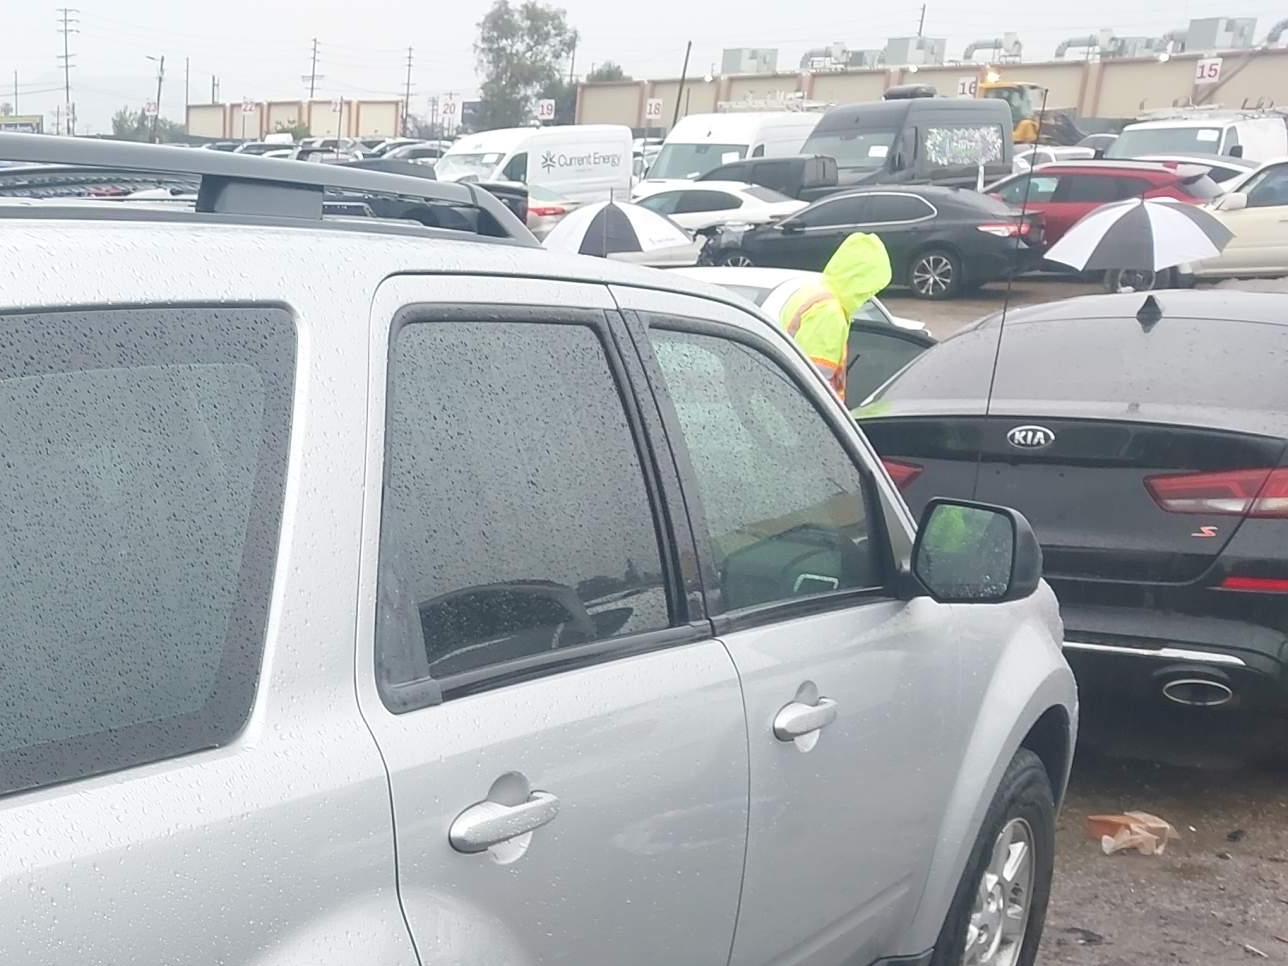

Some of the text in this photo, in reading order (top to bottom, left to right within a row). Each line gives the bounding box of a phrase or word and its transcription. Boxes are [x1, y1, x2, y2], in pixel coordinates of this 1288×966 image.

[1197, 63, 1219, 79] 15
[959, 81, 977, 95] 16
[242, 102, 254, 112] 22
[443, 103, 456, 114] 20
[539, 103, 553, 116] 19
[648, 103, 661, 115] 18
[558, 152, 621, 167] Current Energy
[1014, 430, 1045, 445] KIA
